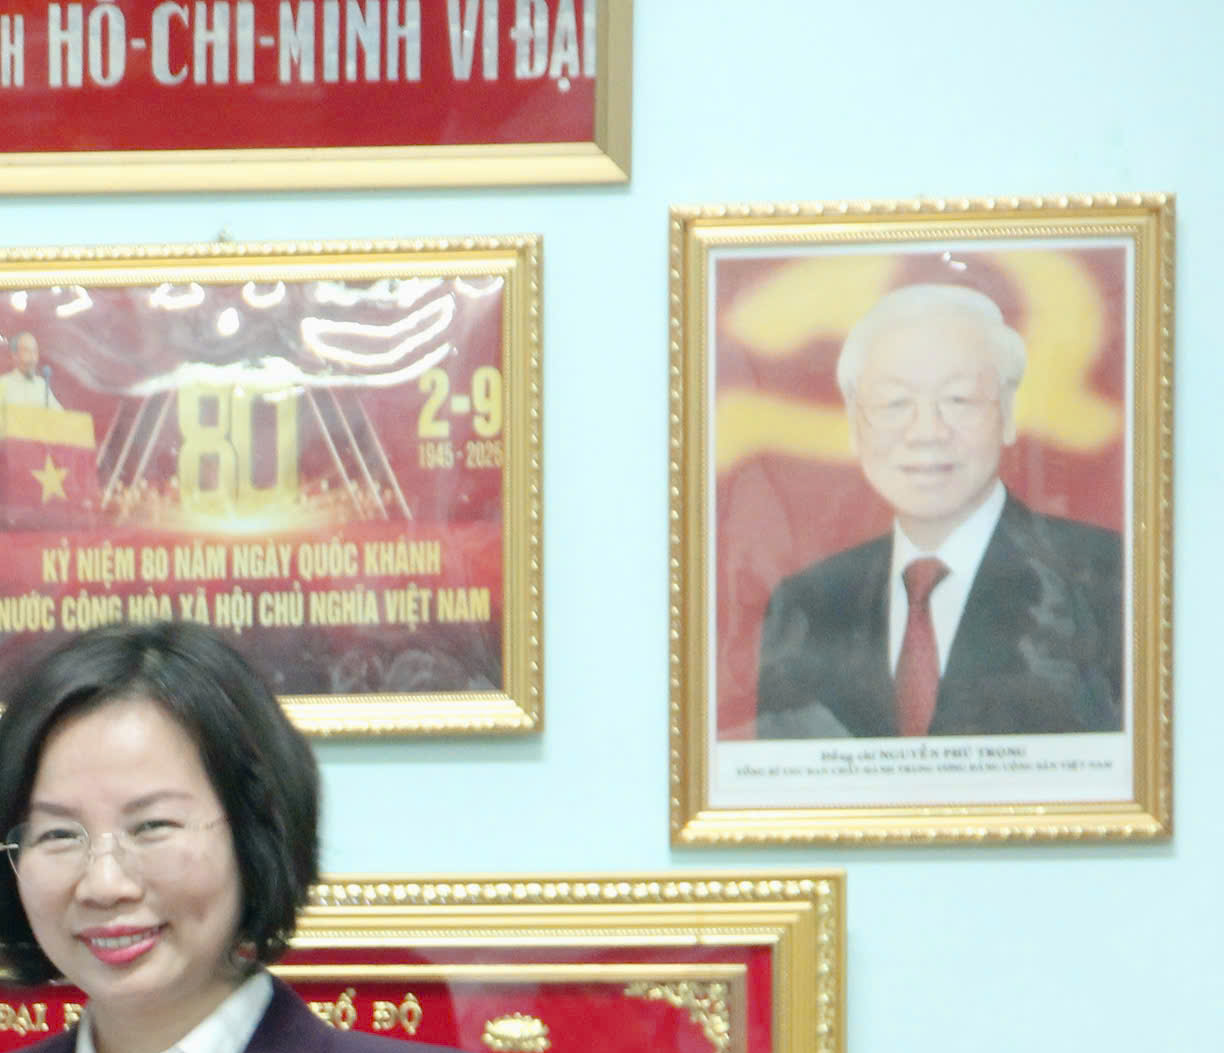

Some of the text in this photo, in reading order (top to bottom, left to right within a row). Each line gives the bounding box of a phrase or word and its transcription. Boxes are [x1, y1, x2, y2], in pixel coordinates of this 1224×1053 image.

[510, 0, 596, 93] ĐẠI
[418, 366, 503, 438] 2-9
[78, 540, 135, 589] NIỆM
[141, 547, 169, 582] 80
[175, 539, 226, 581] NĂM
[232, 537, 292, 580] NGÀY
[298, 532, 359, 581] QUỐC
[363, 535, 442, 576] KHÁNH
[215, 585, 253, 635] HỘI
[258, 581, 305, 627] CHỦ
[384, 582, 432, 633] VIỆT
[436, 588, 491, 624] NAM
[373, 992, 423, 1035] ĐỘ
